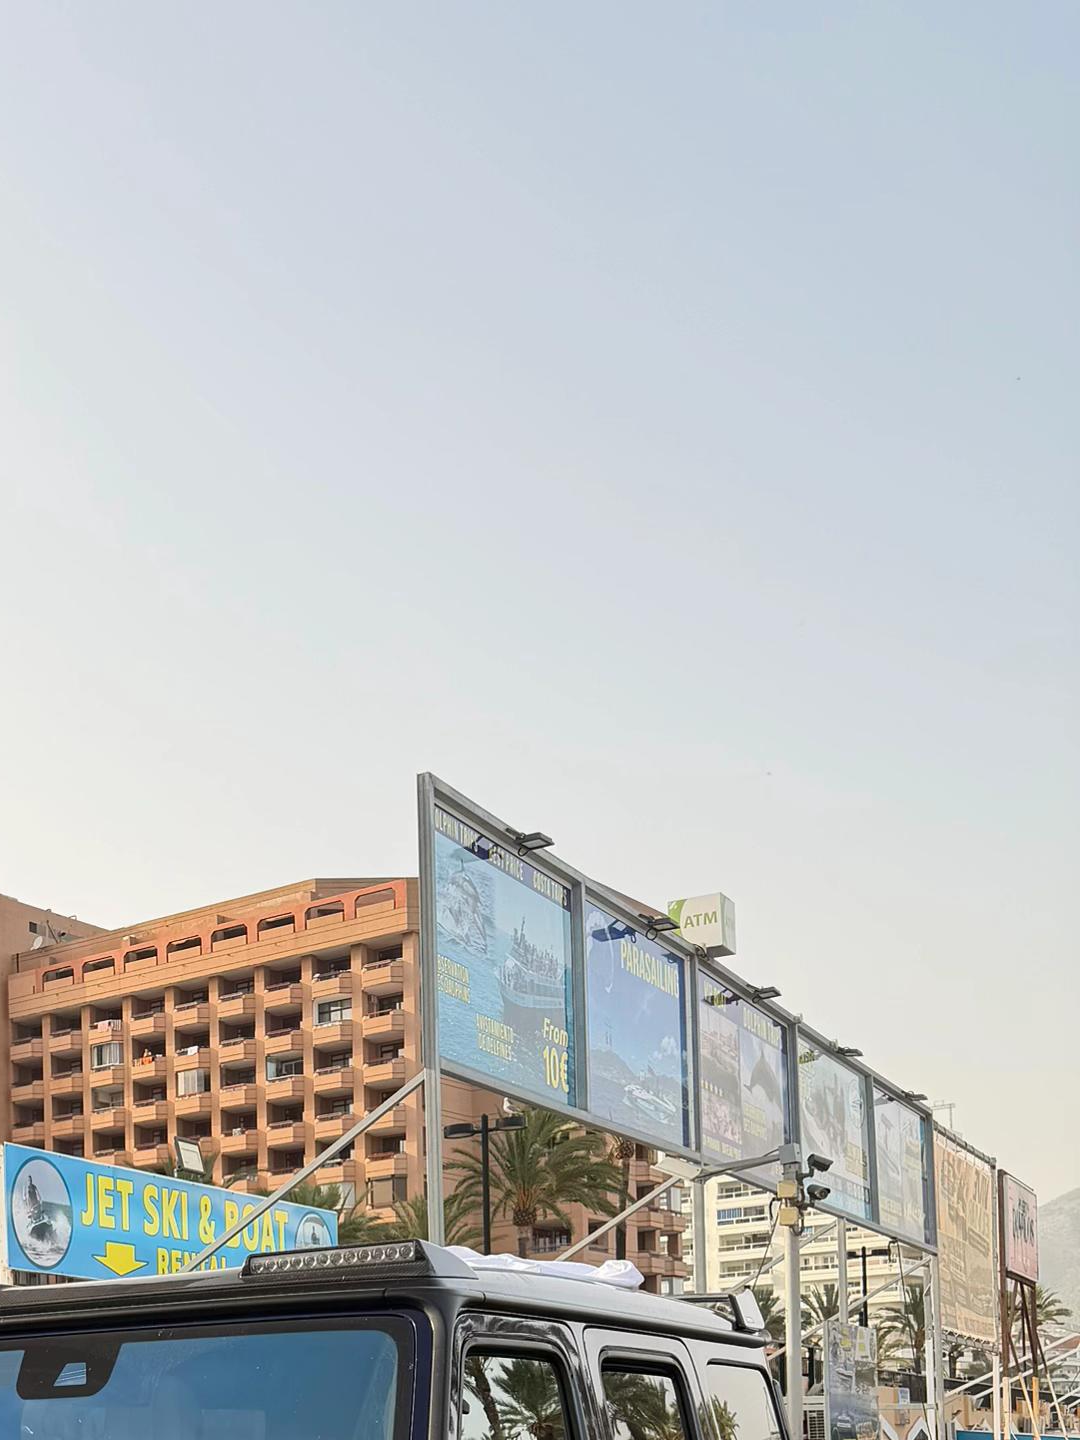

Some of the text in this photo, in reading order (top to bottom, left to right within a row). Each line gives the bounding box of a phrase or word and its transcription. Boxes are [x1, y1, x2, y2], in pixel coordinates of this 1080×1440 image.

[684, 911, 718, 929] ATM
[621, 939, 680, 999] PARASAILING
[543, 1017, 569, 1048] From
[543, 1045, 569, 1093] 10€
[81, 1172, 290, 1254] JET SKI & BOAT
